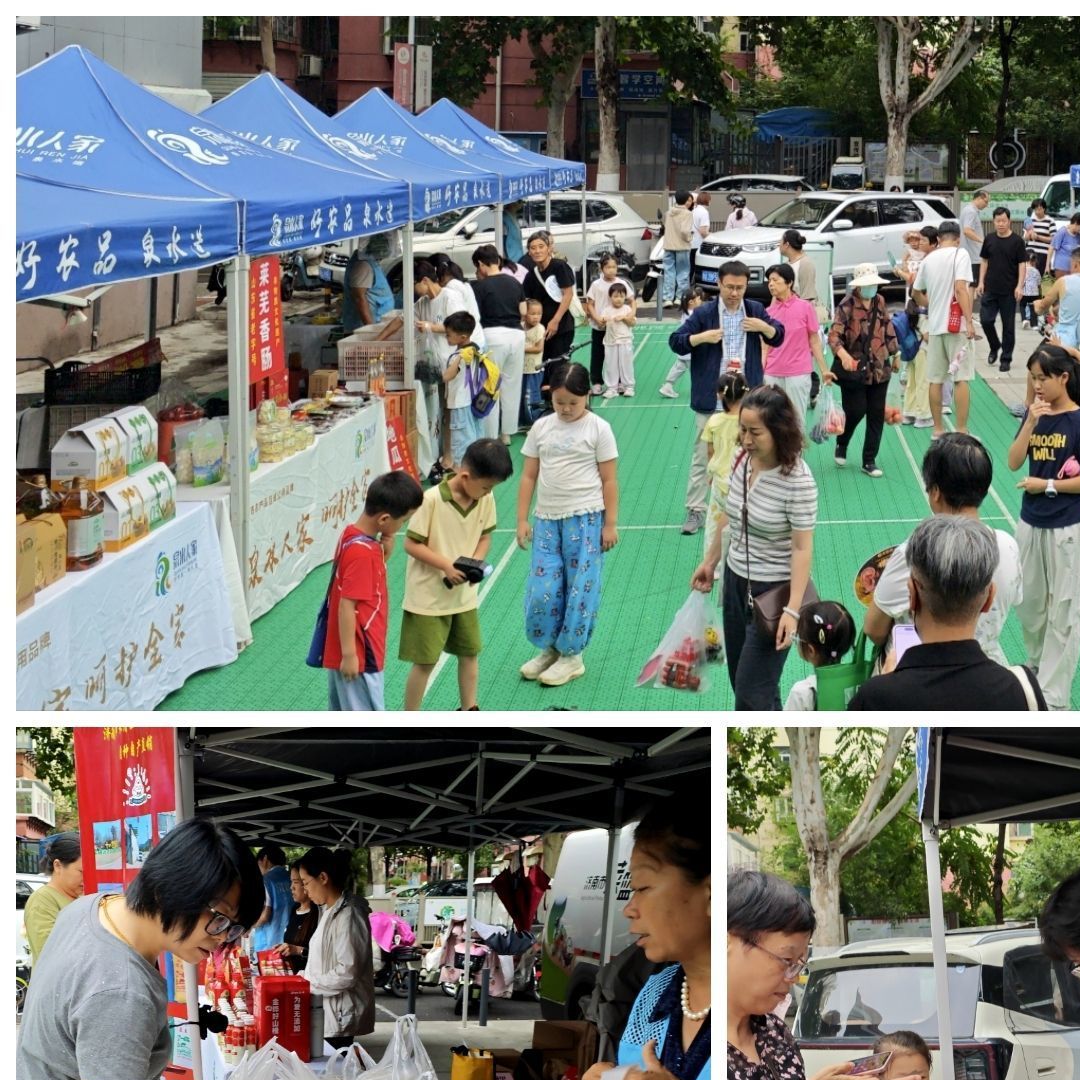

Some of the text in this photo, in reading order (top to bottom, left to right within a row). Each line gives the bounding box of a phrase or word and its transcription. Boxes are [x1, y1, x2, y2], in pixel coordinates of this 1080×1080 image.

[310, 202, 354, 239] 好农品
[363, 199, 394, 229] 泉水造
[16, 224, 212, 291] 好农品 泉水造
[259, 262, 273, 372] 莱芜香肠
[1033, 446, 1056, 461] WILL
